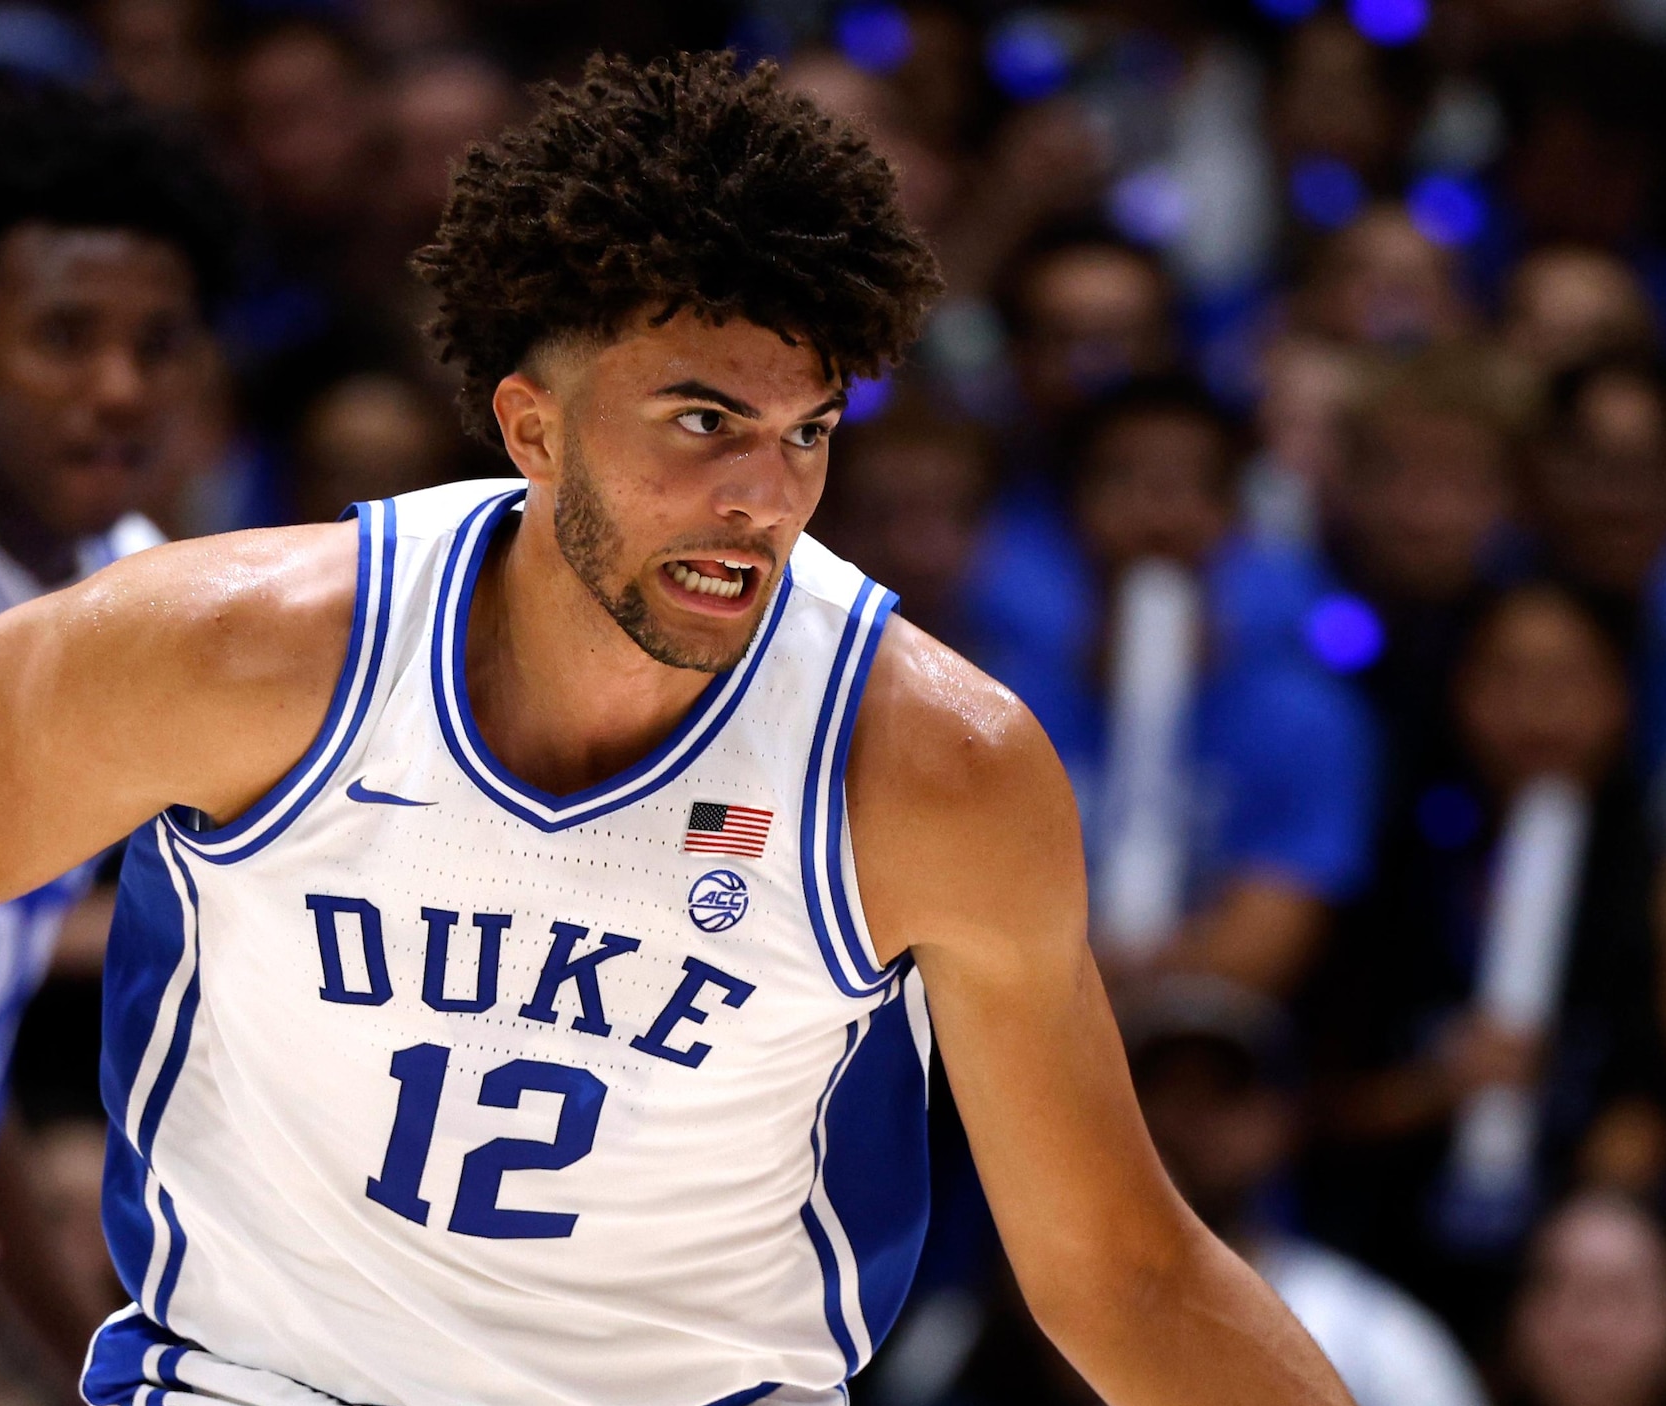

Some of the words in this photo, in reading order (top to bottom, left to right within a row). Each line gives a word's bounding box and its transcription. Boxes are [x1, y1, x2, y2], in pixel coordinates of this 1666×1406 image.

[305, 893, 758, 1069] DUKE
[696, 890, 748, 906] ACC
[365, 1042, 609, 1240] 12
